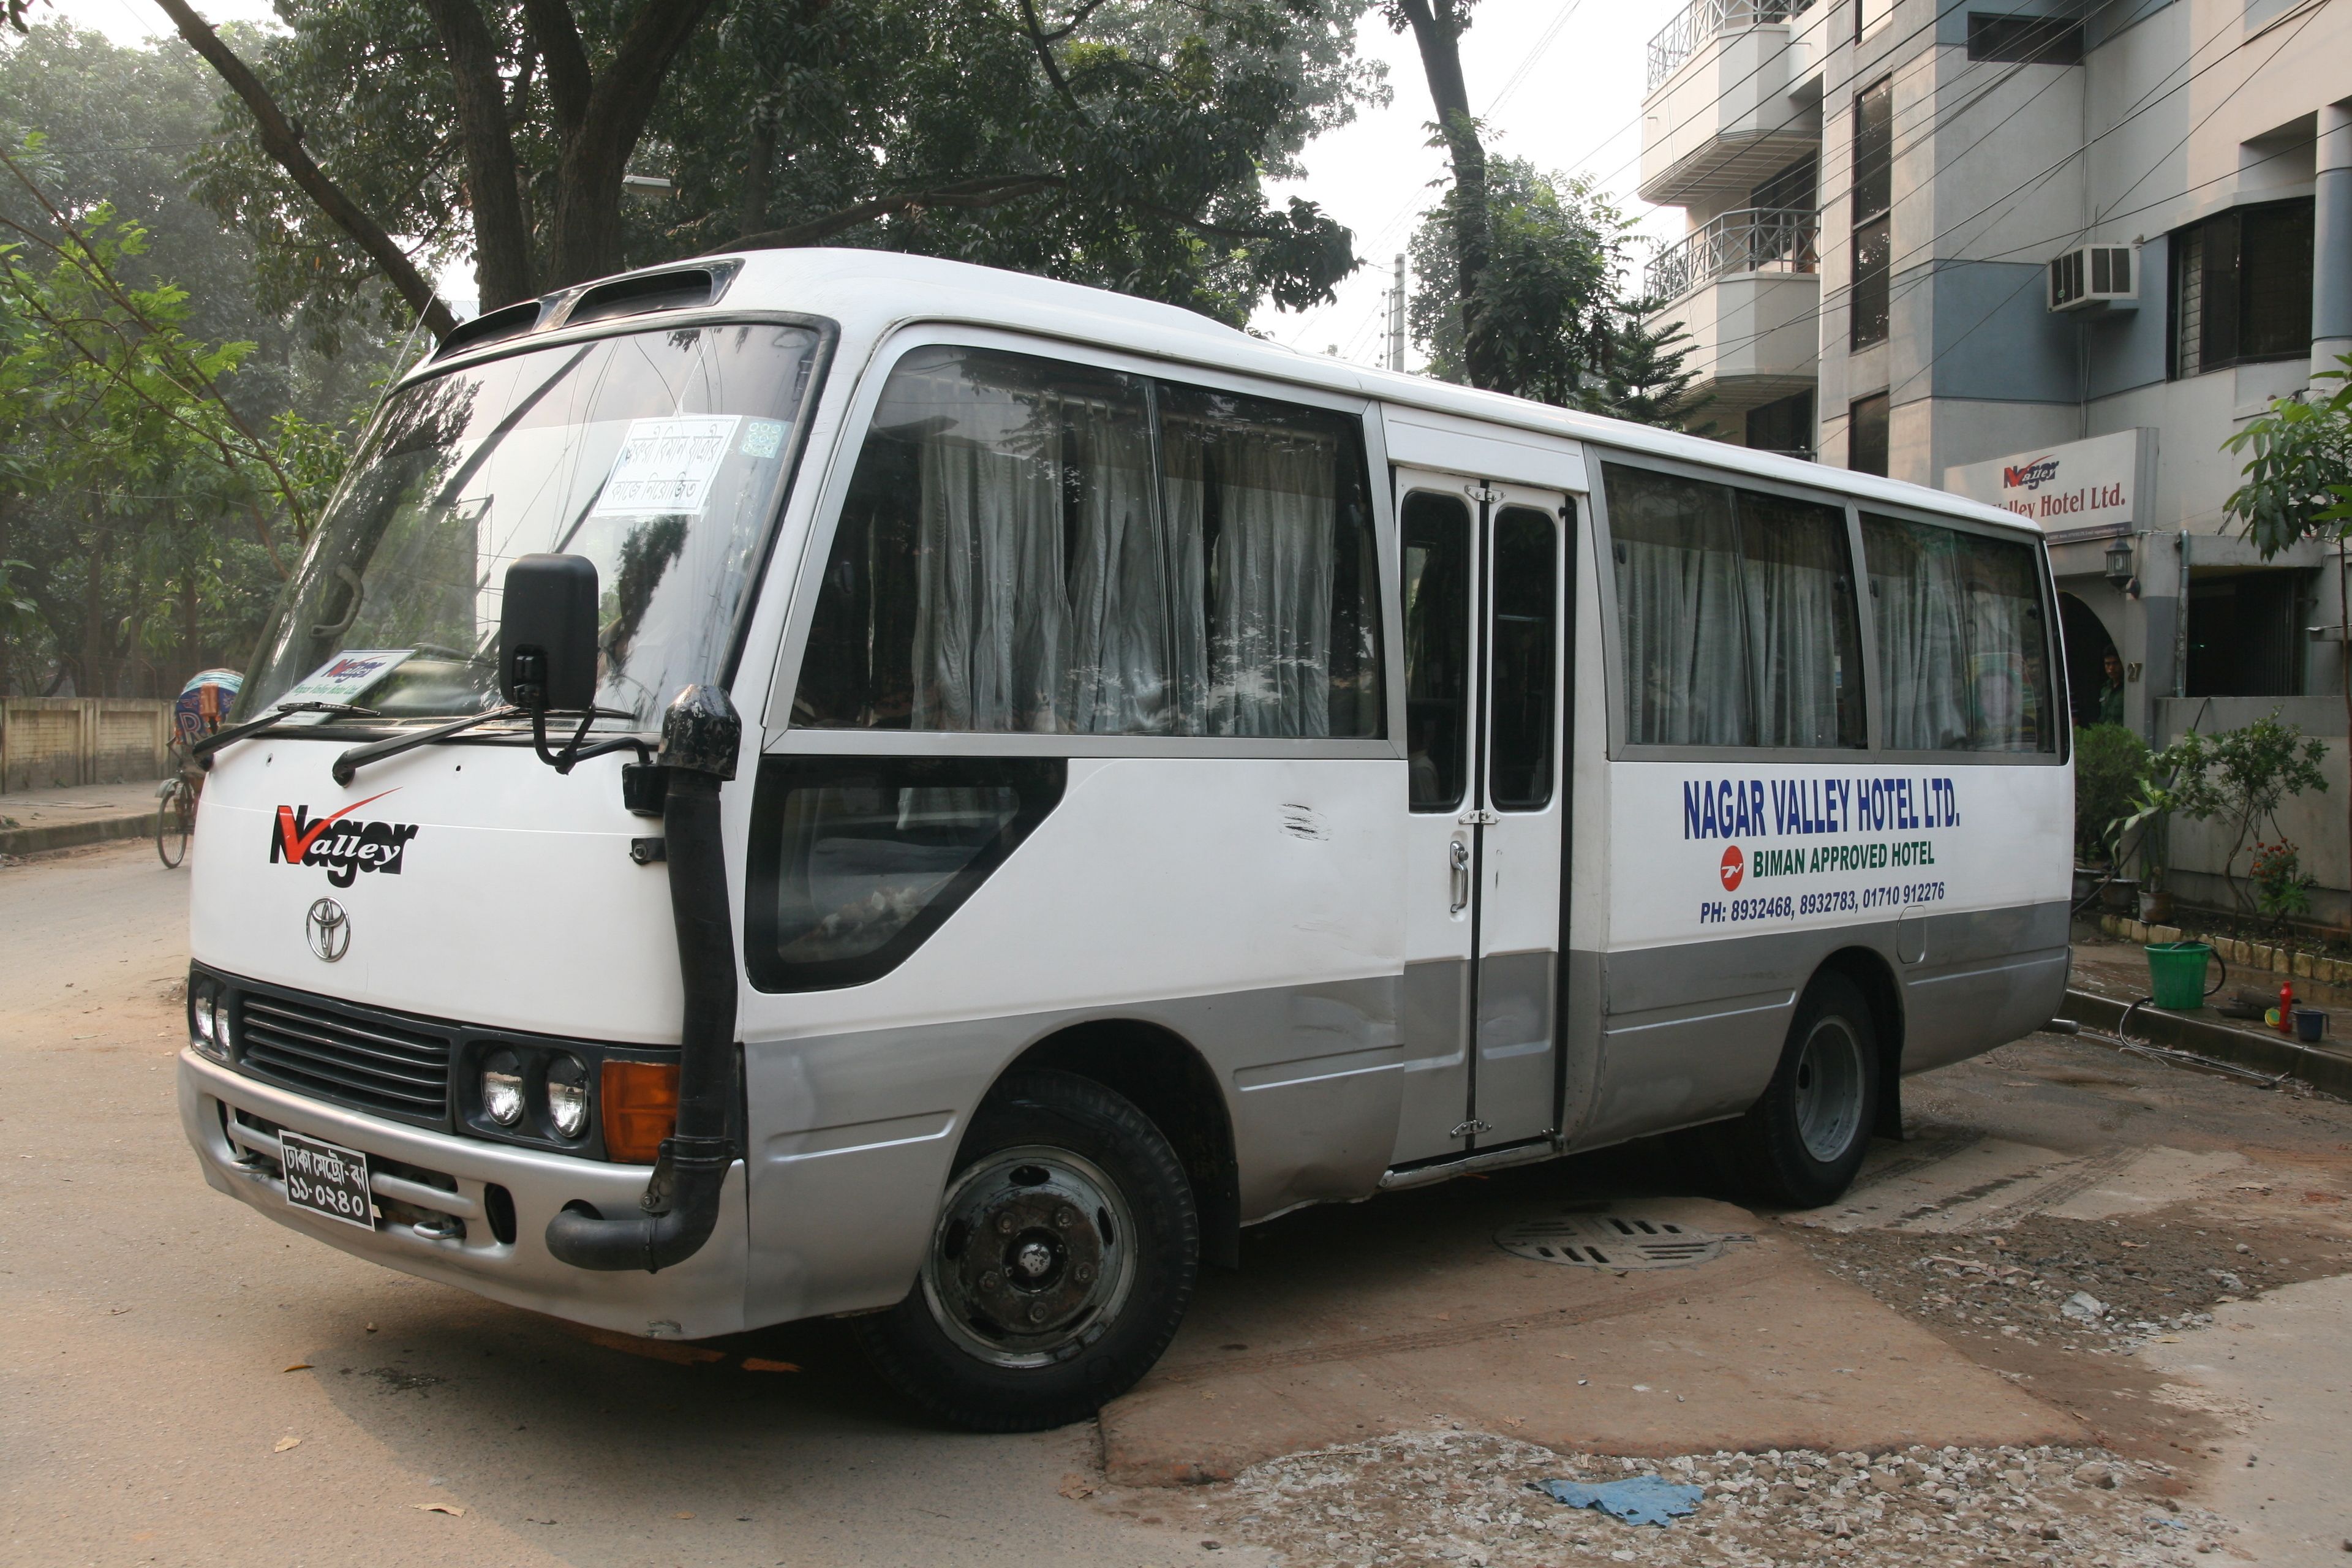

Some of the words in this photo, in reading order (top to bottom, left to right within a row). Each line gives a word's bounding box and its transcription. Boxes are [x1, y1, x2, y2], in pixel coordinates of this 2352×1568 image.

[660, 426, 690, 464] বিমান
[612, 480, 644, 501] কাজে
[641, 471, 701, 500] নিয়োজিত
[2005, 454, 2056, 487] Valley
[2040, 489, 2085, 518] Hotel
[2090, 482, 2126, 510] Ltd.
[2127, 662, 2143, 682] 27
[277, 786, 404, 866] Valley
[1683, 780, 1766, 840] NAGAR
[1771, 778, 1850, 835] VALLEY
[1856, 777, 1919, 832] HOTEL
[1923, 777, 1961, 828] LTD.
[270, 805, 420, 889] Nagar
[1752, 848, 1805, 878] BIMAN
[1809, 843, 1887, 873] APPROVED
[1891, 840, 1935, 867] HOTEL
[1700, 901, 1727, 924] PH:
[1730, 895, 1795, 922] 8932468,
[1800, 891, 1858, 916] 8932783,
[1862, 886, 1900, 908] 01710
[1902, 881, 1945, 904] 912276
[283, 1144, 312, 1175] ঢাকা
[290, 1175, 364, 1217] ১১-০২৪০
